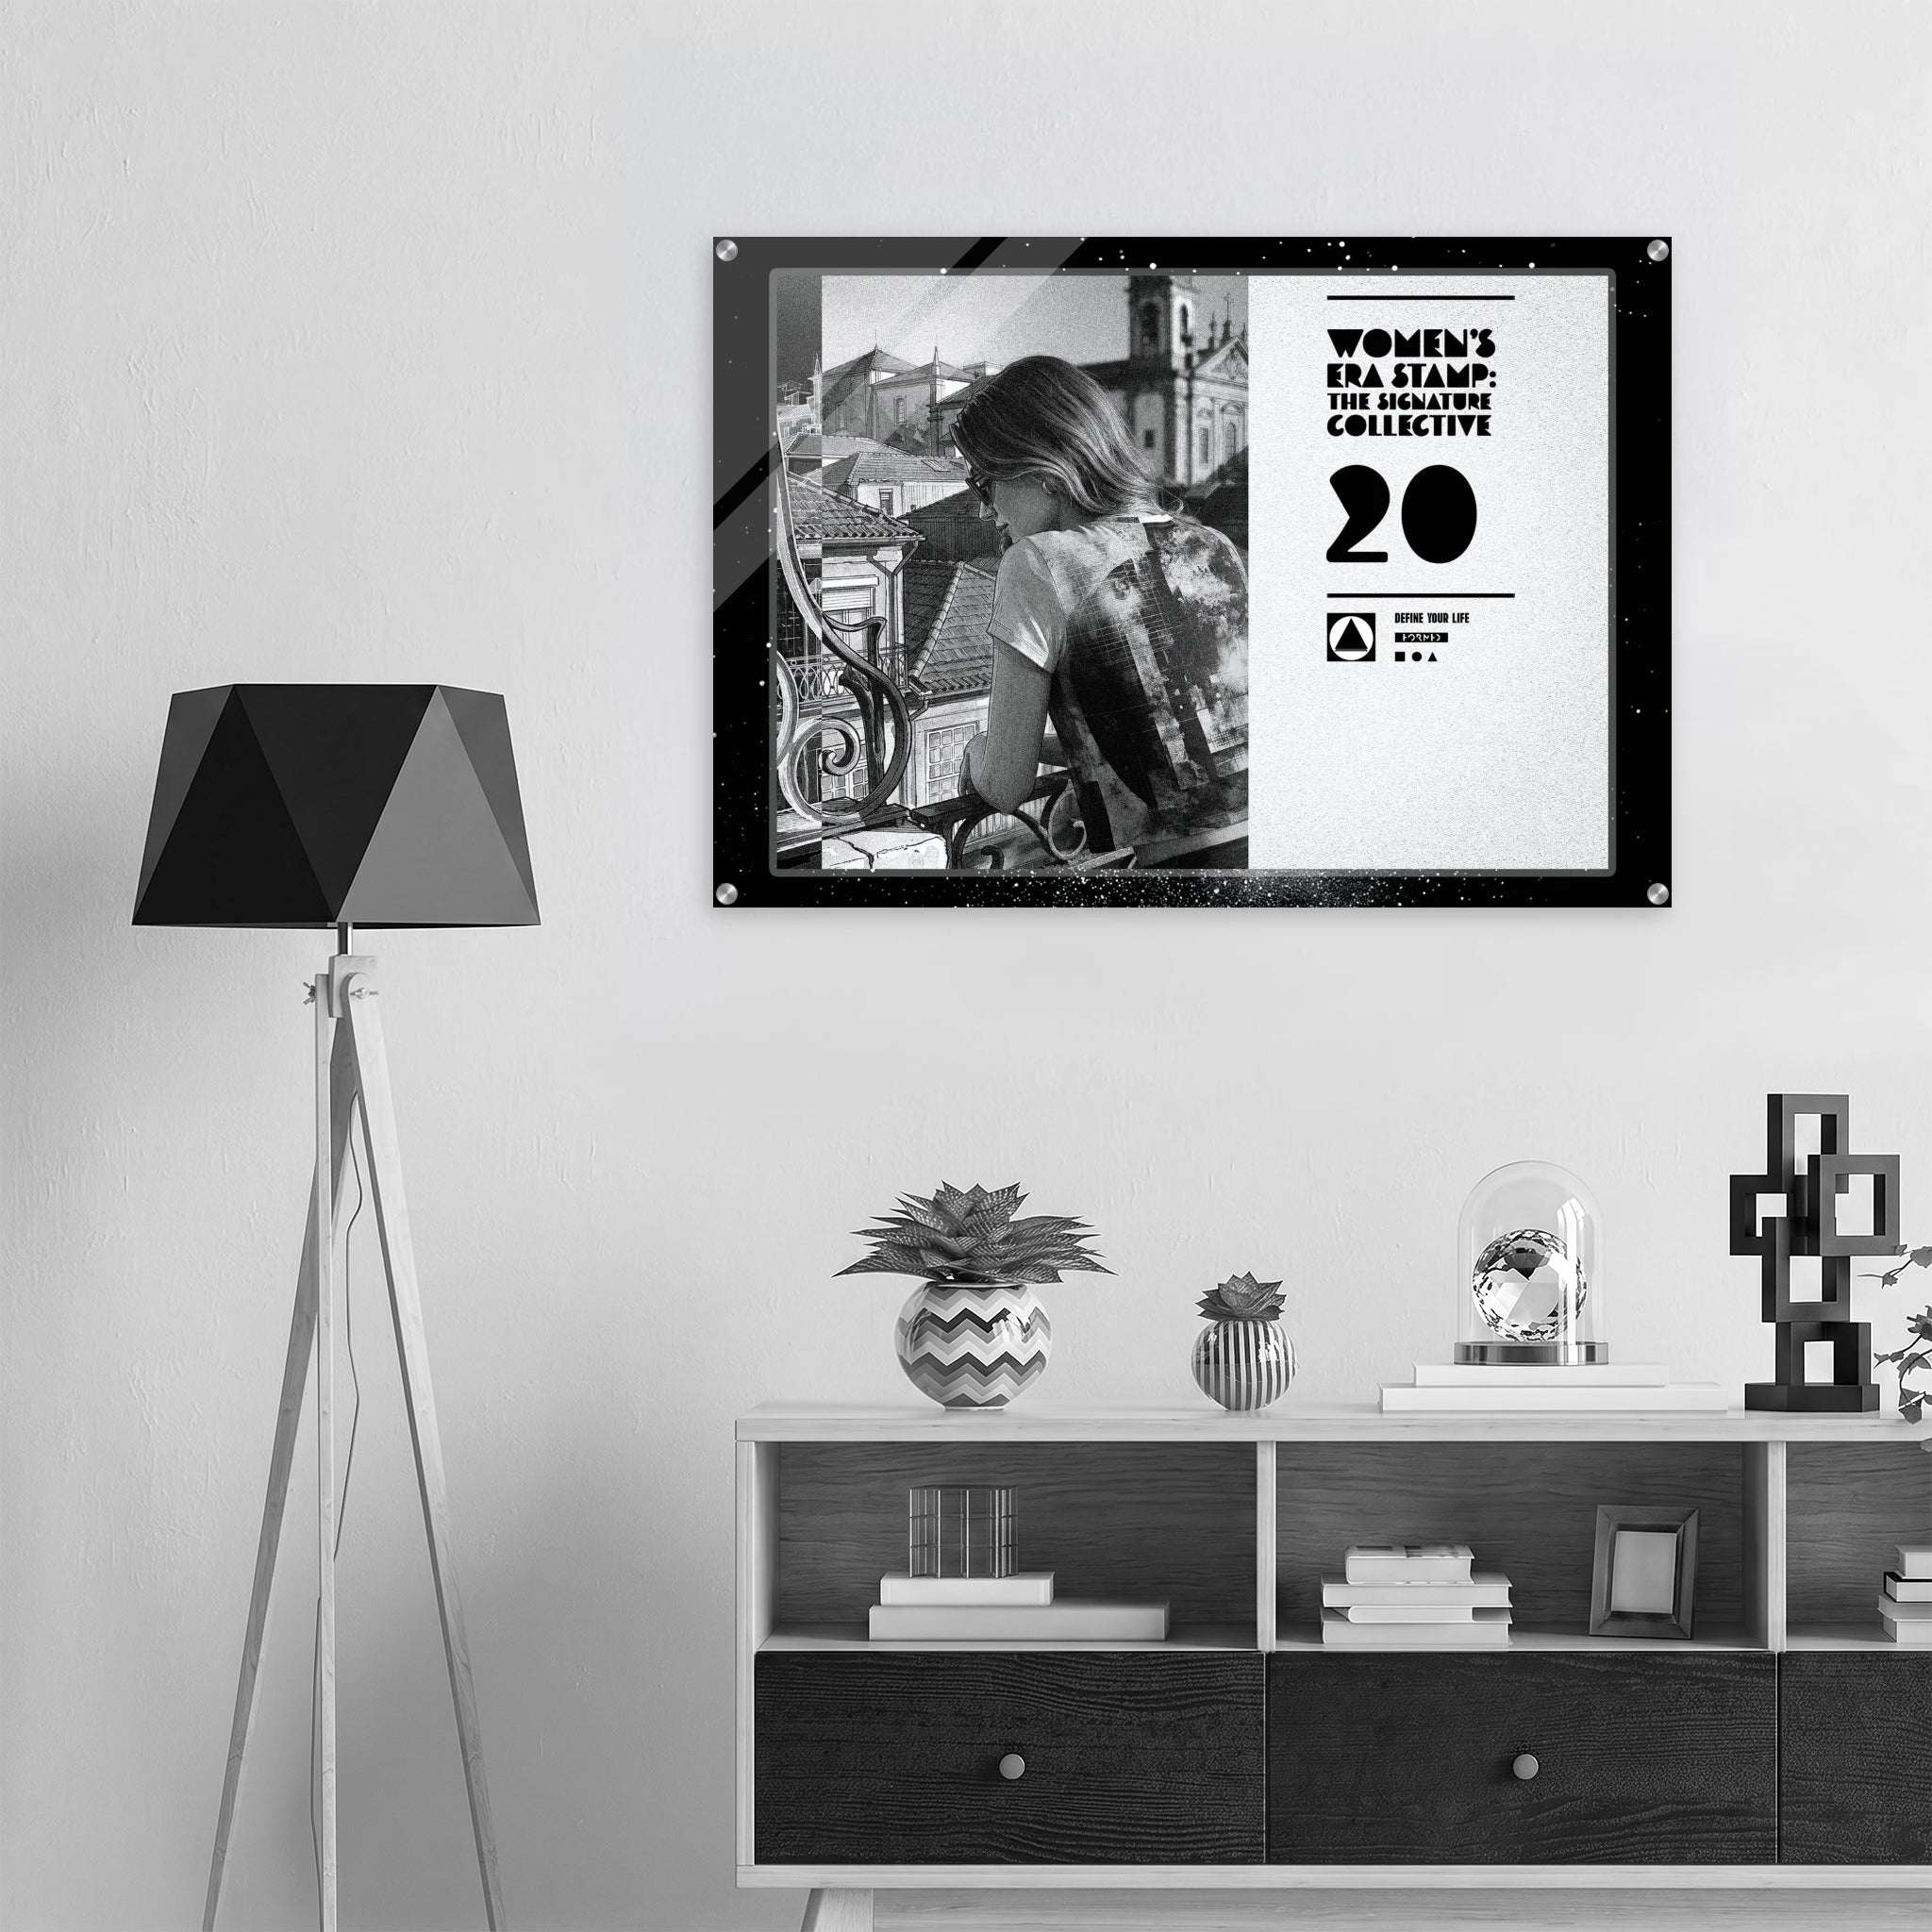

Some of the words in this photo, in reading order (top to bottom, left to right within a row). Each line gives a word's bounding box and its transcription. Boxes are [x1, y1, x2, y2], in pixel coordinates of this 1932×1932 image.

[1327, 329, 1495, 358] WOMEN'S
[1327, 363, 1384, 388] ERA
[1391, 363, 1496, 388] STAMP:
[1328, 393, 1370, 409] THE
[1377, 393, 1491, 409] SIGNATURE
[1327, 415, 1491, 437] COLLECTIVE
[1326, 465, 1476, 563] 20
[1395, 613, 1423, 623] DEFINE
[1427, 613, 1448, 623] YOUR
[1453, 613, 1469, 623] LIFE
